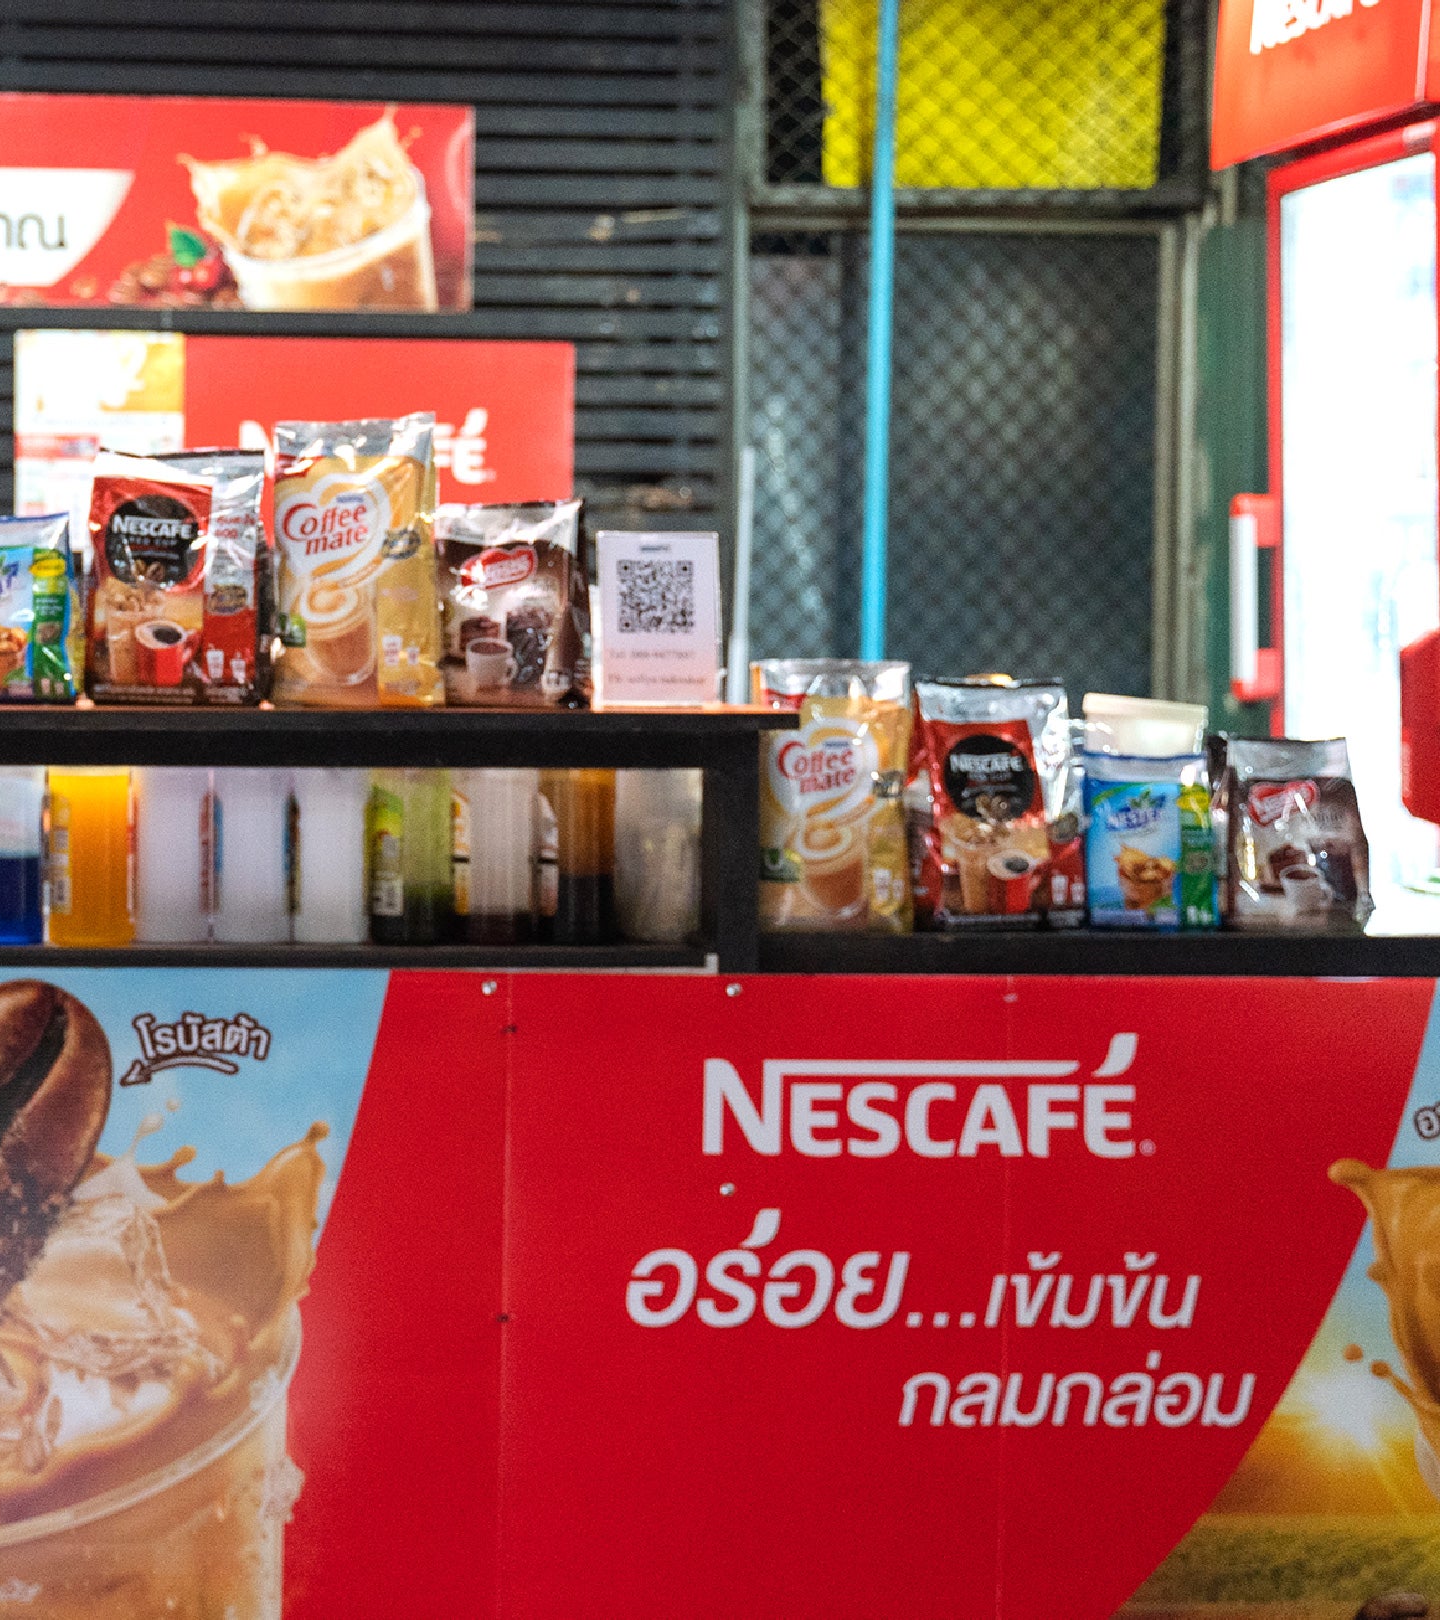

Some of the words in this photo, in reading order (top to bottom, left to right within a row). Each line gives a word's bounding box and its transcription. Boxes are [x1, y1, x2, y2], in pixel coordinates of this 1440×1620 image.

[281, 502, 367, 541] Coffee
[305, 524, 368, 556] mate
[778, 740, 856, 780] Coffee
[799, 767, 856, 793] mate
[133, 1010, 271, 1061] โรบัสต้า
[702, 1033, 1139, 1158] NESCAFÉ
[898, 1350, 1256, 1427] กลมกล่อม
